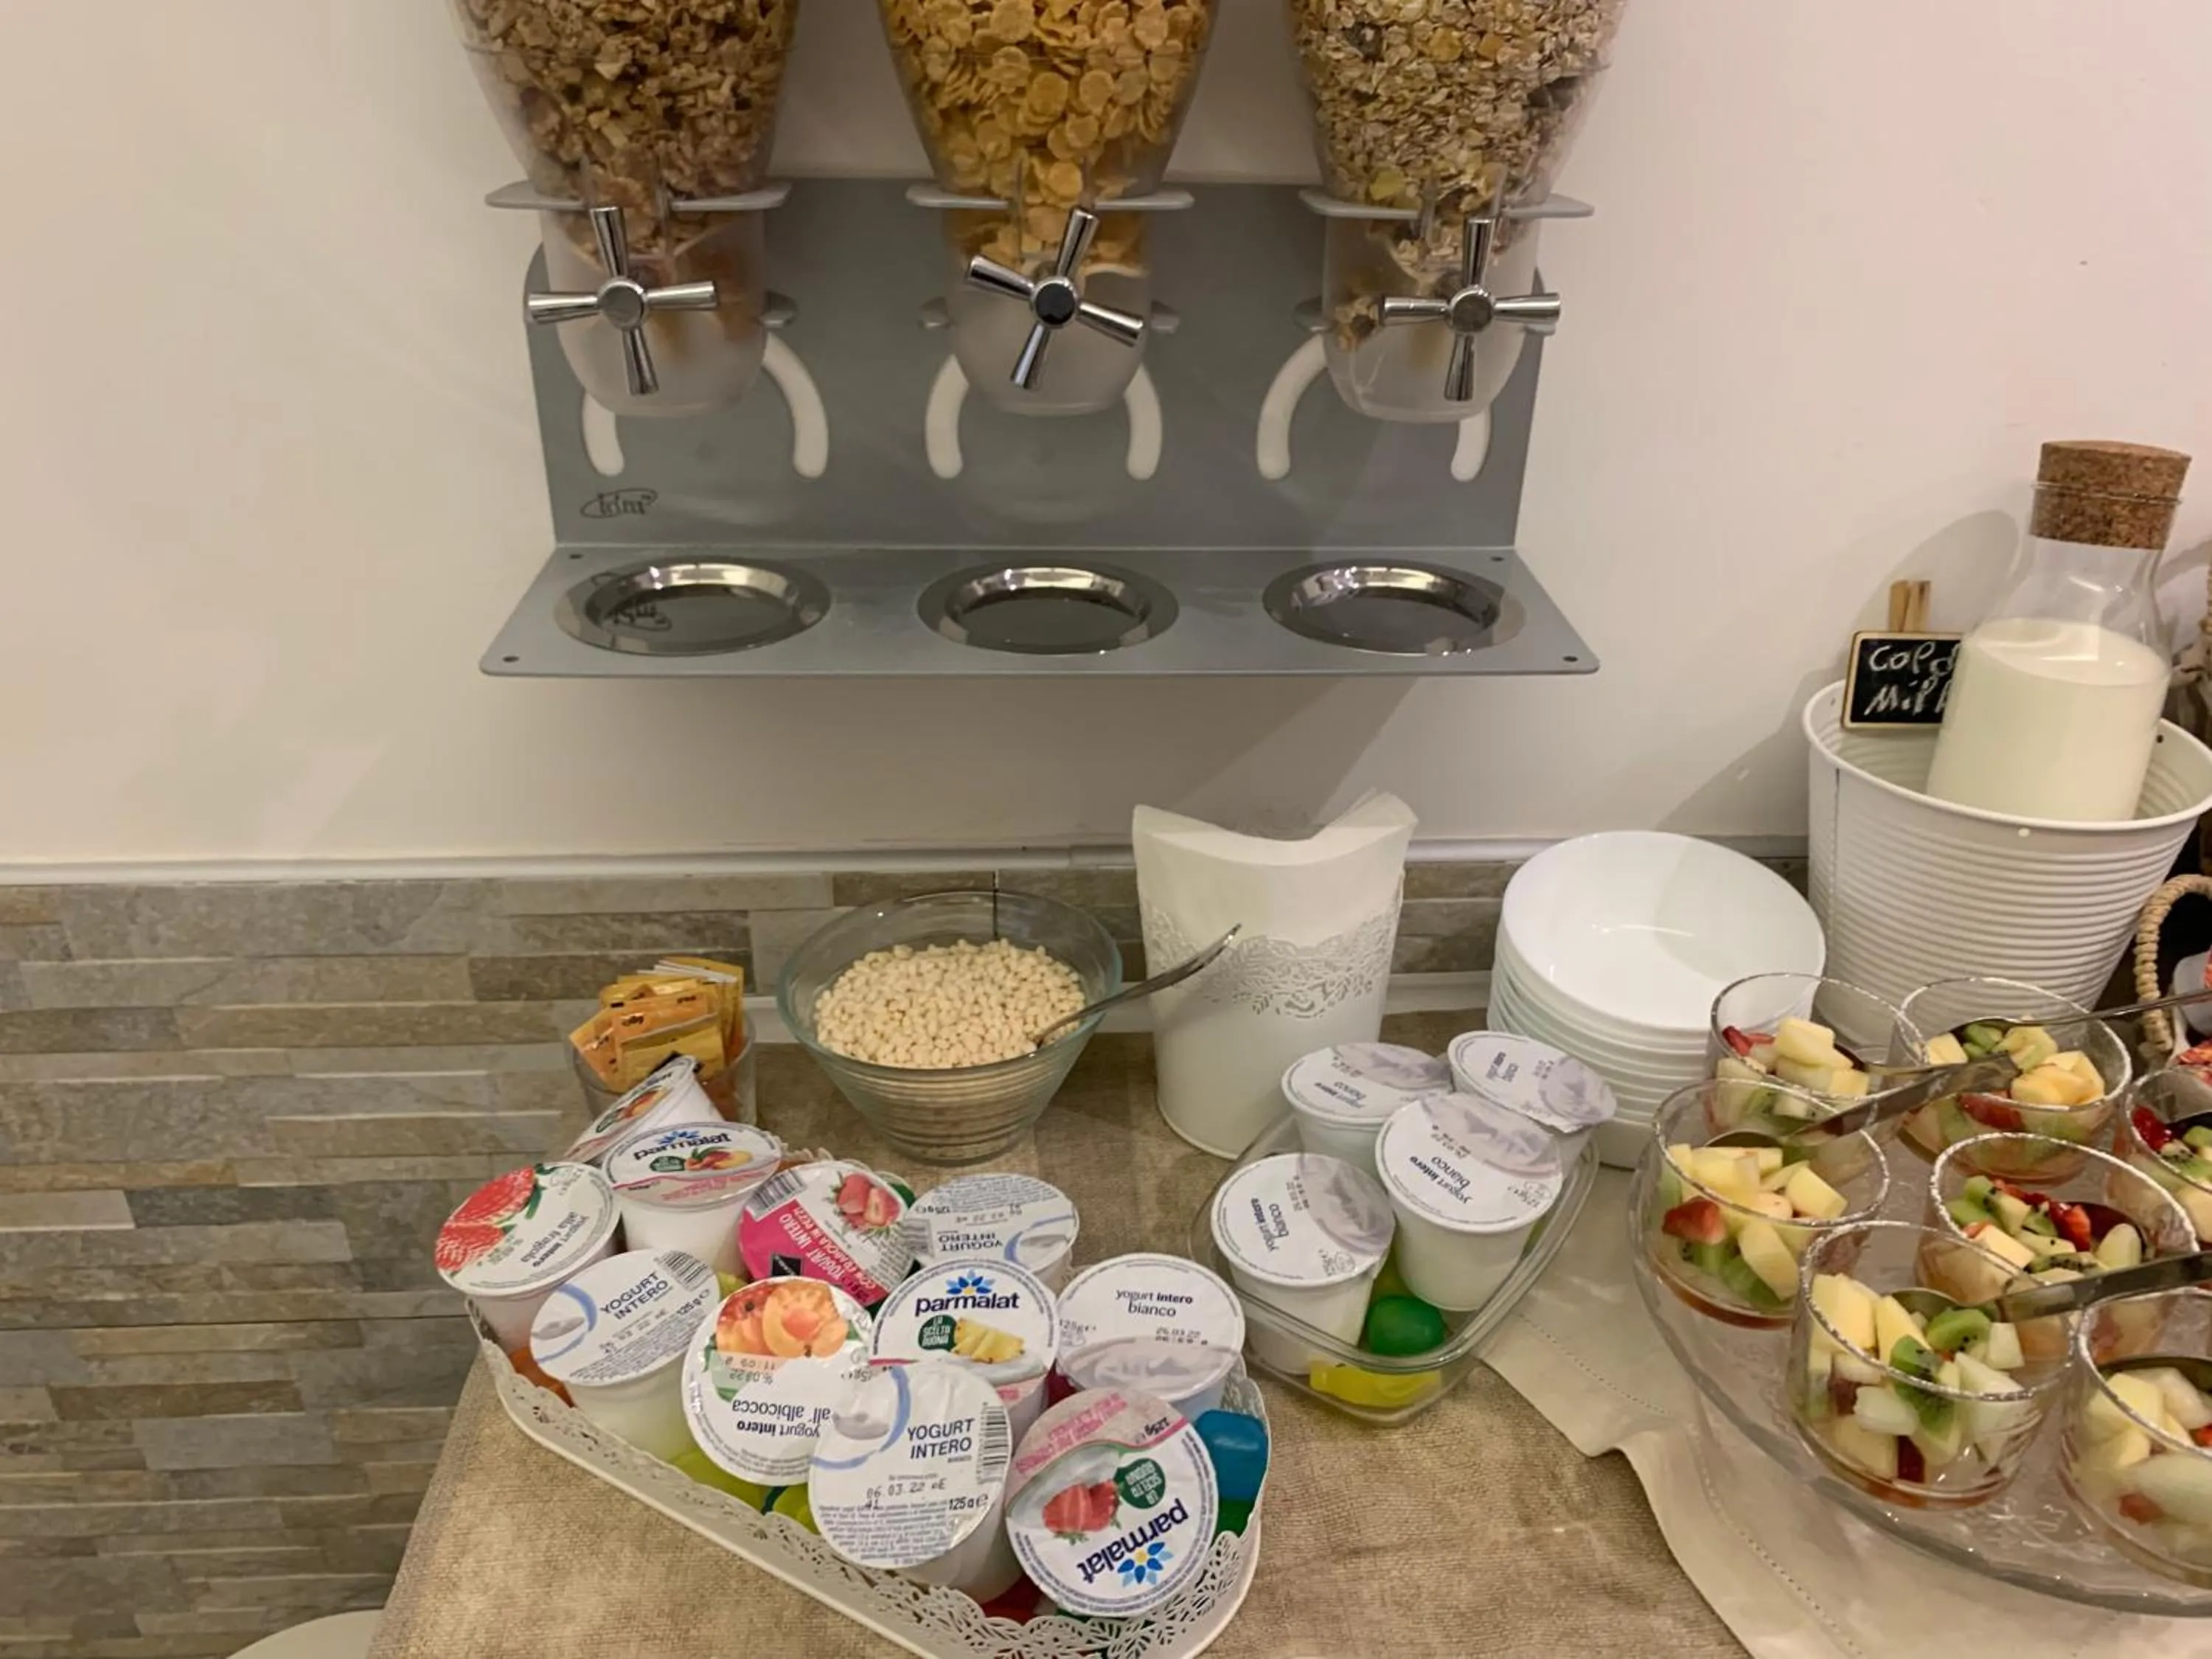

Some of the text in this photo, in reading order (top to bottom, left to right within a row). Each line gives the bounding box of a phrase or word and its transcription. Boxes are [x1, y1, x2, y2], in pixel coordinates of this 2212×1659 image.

[633, 1133, 732, 1161] parmalat
[1409, 1155, 1474, 1204] yogurt intero
[1431, 1155, 1471, 1192] bianco
[779, 1213, 813, 1250] INTERO
[1251, 1197, 1280, 1252] yogurt intero
[1268, 1203, 1289, 1239] bianco
[938, 1232, 995, 1243] INTERO
[941, 1239, 1003, 1252] YOGURT
[806, 1248, 845, 1281] YOGURT
[600, 1270, 659, 1315] YOGURT
[613, 1280, 669, 1320] INTERO
[914, 1293, 1020, 1317] parmalat
[1115, 1289, 1194, 1304] yogurt intero
[1127, 1301, 1177, 1318] bianco
[732, 1399, 805, 1422] albicocca
[737, 1419, 821, 1438] yogurt intero
[908, 1418, 975, 1441] YOGURT
[910, 1437, 972, 1459] INTERO
[1077, 1498, 1189, 1584] parmalat
